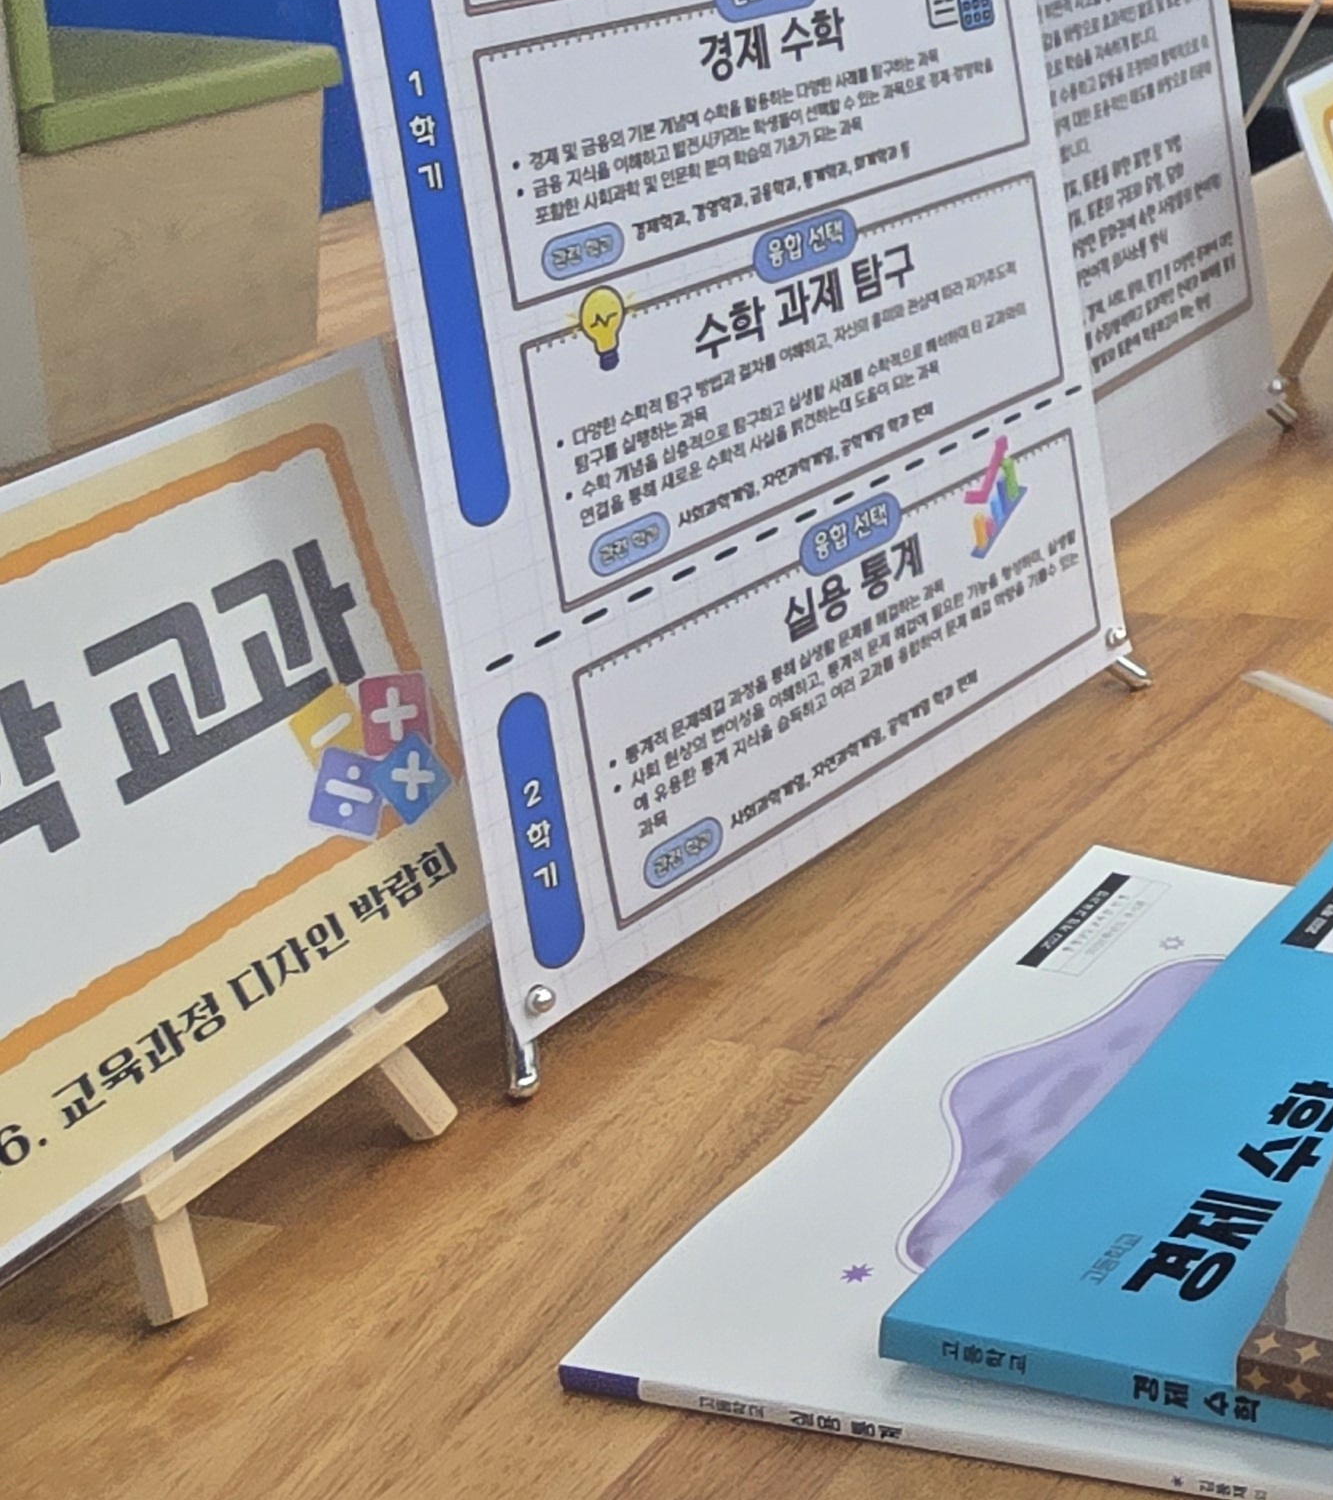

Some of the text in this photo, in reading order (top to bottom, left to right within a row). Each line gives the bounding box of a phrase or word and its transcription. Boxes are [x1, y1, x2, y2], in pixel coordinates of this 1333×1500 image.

[698, 5, 846, 83] 경제 수학
[407, 69, 444, 191] 1학기
[529, 77, 832, 171] 경제 및 금융의 기본 수학을 다양한
[532, 144, 671, 199] 금융 지식을 이해하고
[534, 173, 658, 226] 포함한 사회과학 및
[767, 218, 845, 269] 융합 선택
[694, 243, 916, 360] 수학 과제 탐구
[571, 384, 694, 446] 다양한 수학적 탐구
[574, 404, 709, 475] 탐구를 실행하는 과목
[581, 399, 786, 498] 수학 개념을 탐구하고
[579, 460, 703, 529] 연결을 새로운
[813, 503, 889, 561] 융합 선택
[783, 532, 925, 644] 실용 통계
[82, 538, 366, 806] 교과
[624, 673, 769, 766] 통계적 문제해결 과정을
[630, 701, 767, 789] 사회 현상의 변이성을
[653, 691, 829, 804] 유용한 통계 지식을 습득하고
[522, 778, 559, 889] 2학기
[637, 808, 669, 840] 과목
[50, 991, 227, 1130] 교육과정
[226, 911, 351, 1012] 디자인
[348, 841, 459, 925] 박람회
[1080, 1230, 1143, 1286] 고등학교
[1120, 1188, 1282, 1302] 경제
[699, 1393, 903, 1443] 고등학교 실용 통계
[939, 1340, 1261, 1424] 고등학교 경제 수학
